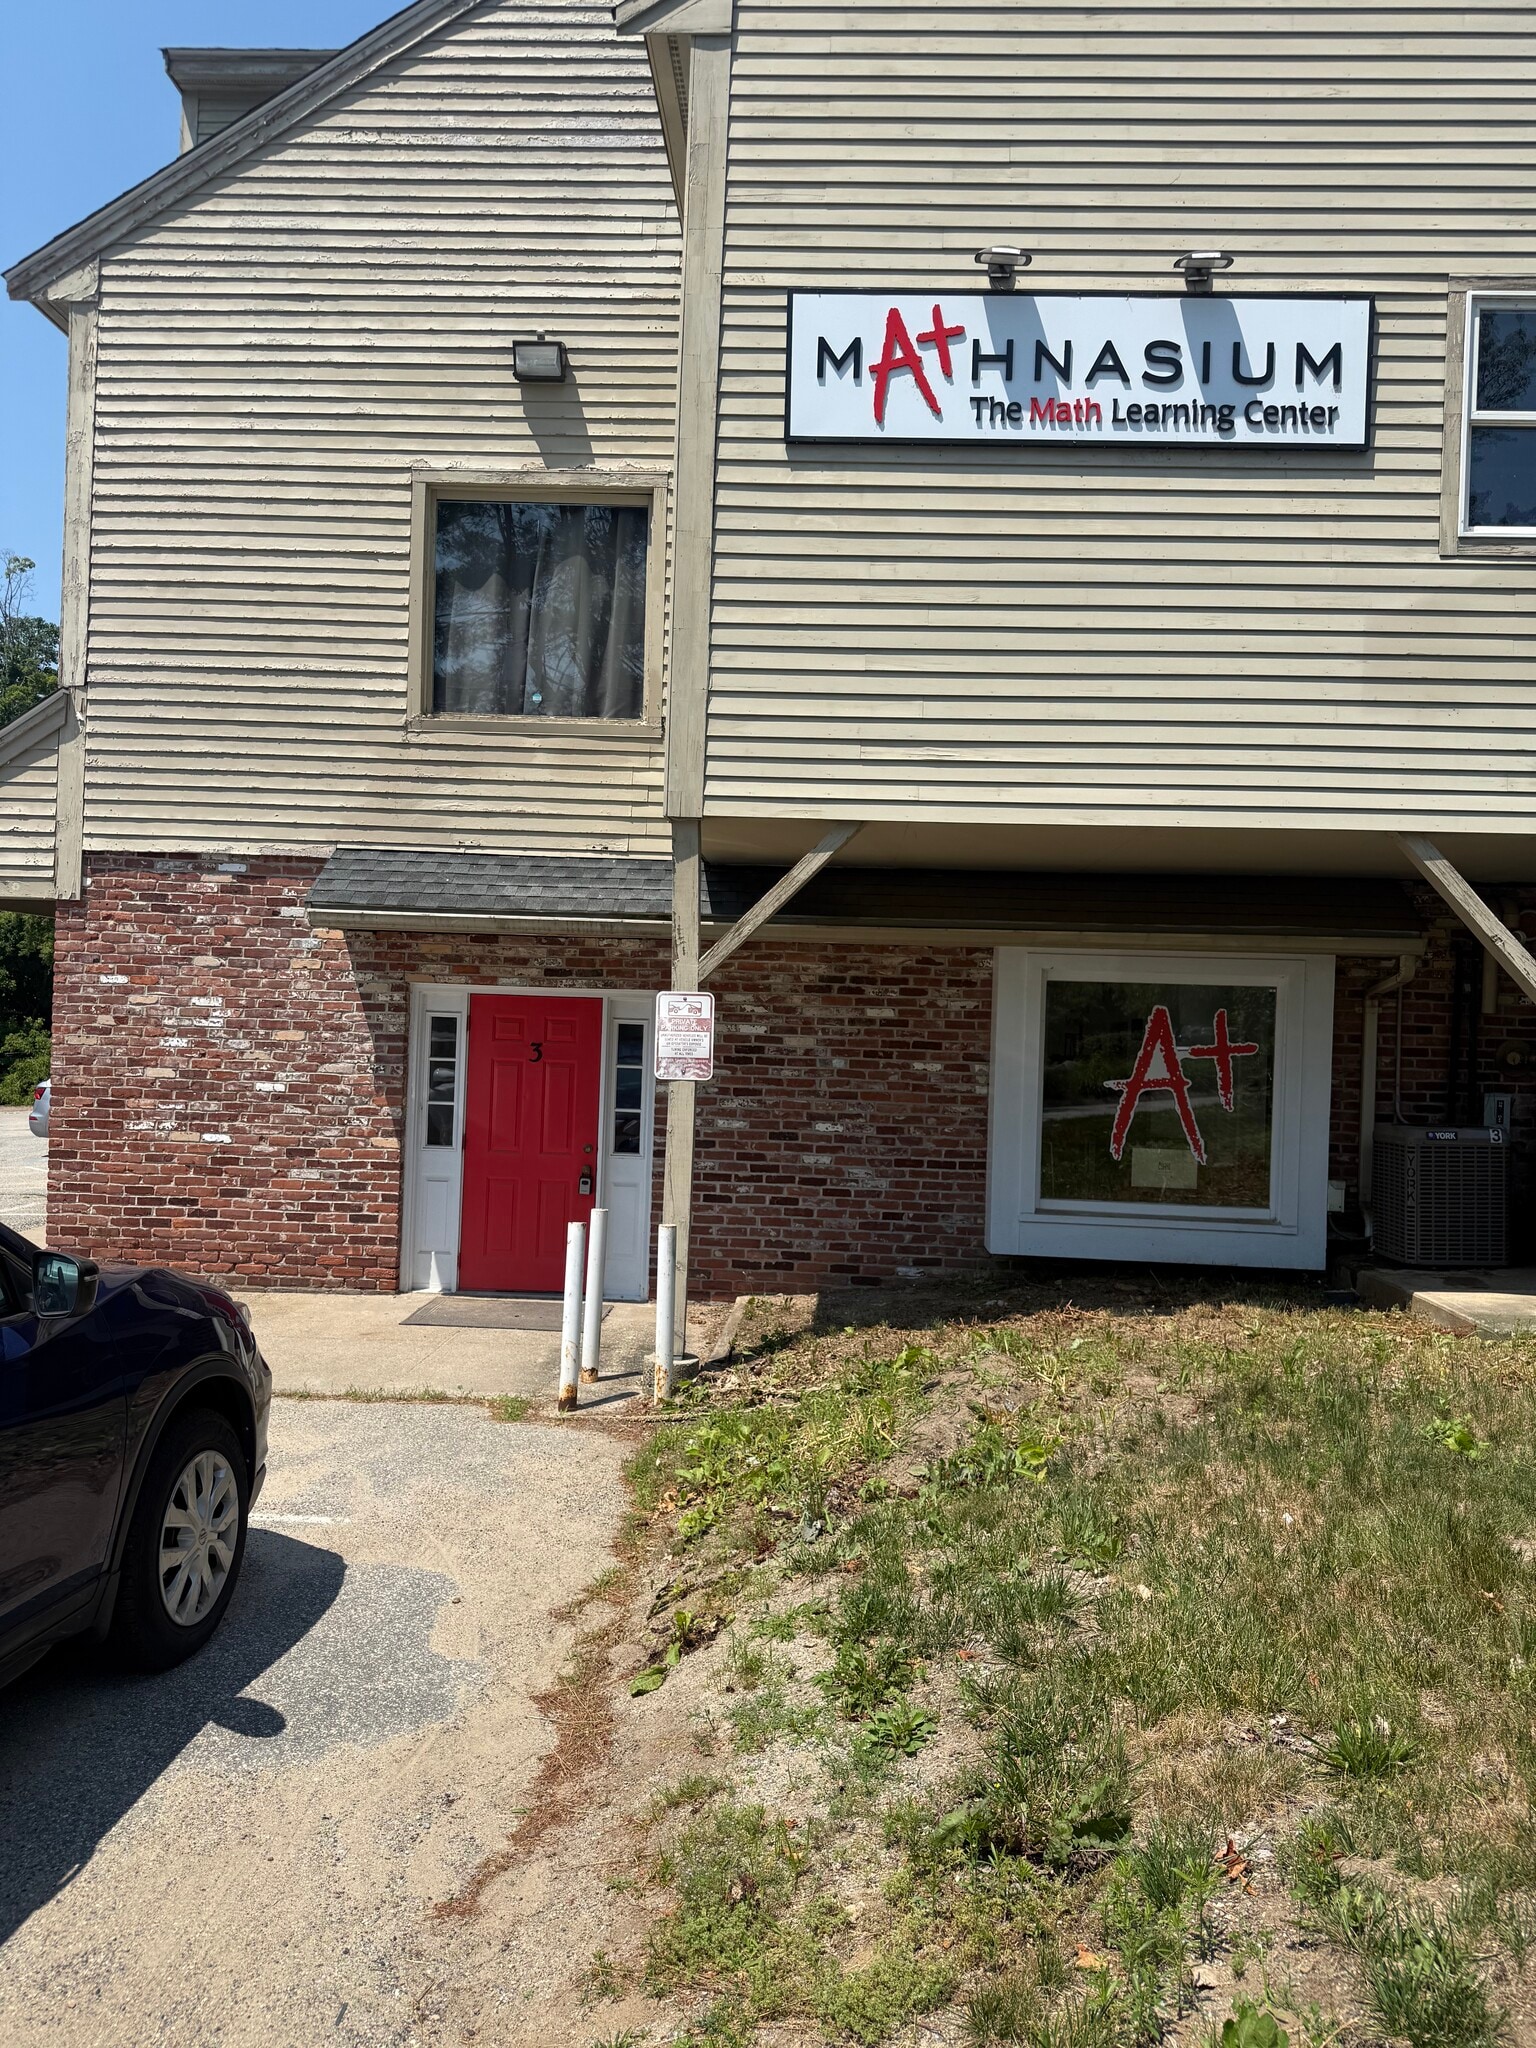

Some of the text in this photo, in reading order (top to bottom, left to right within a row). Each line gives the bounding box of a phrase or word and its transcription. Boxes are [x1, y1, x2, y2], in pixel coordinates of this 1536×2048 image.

[969, 396, 1338, 431] The Math Learning Center
[529, 1042, 543, 1063] 3
[1435, 1132, 1457, 1140] YORK
[1492, 1129, 1502, 1142] 3
[1406, 1155, 1416, 1202] YORK
